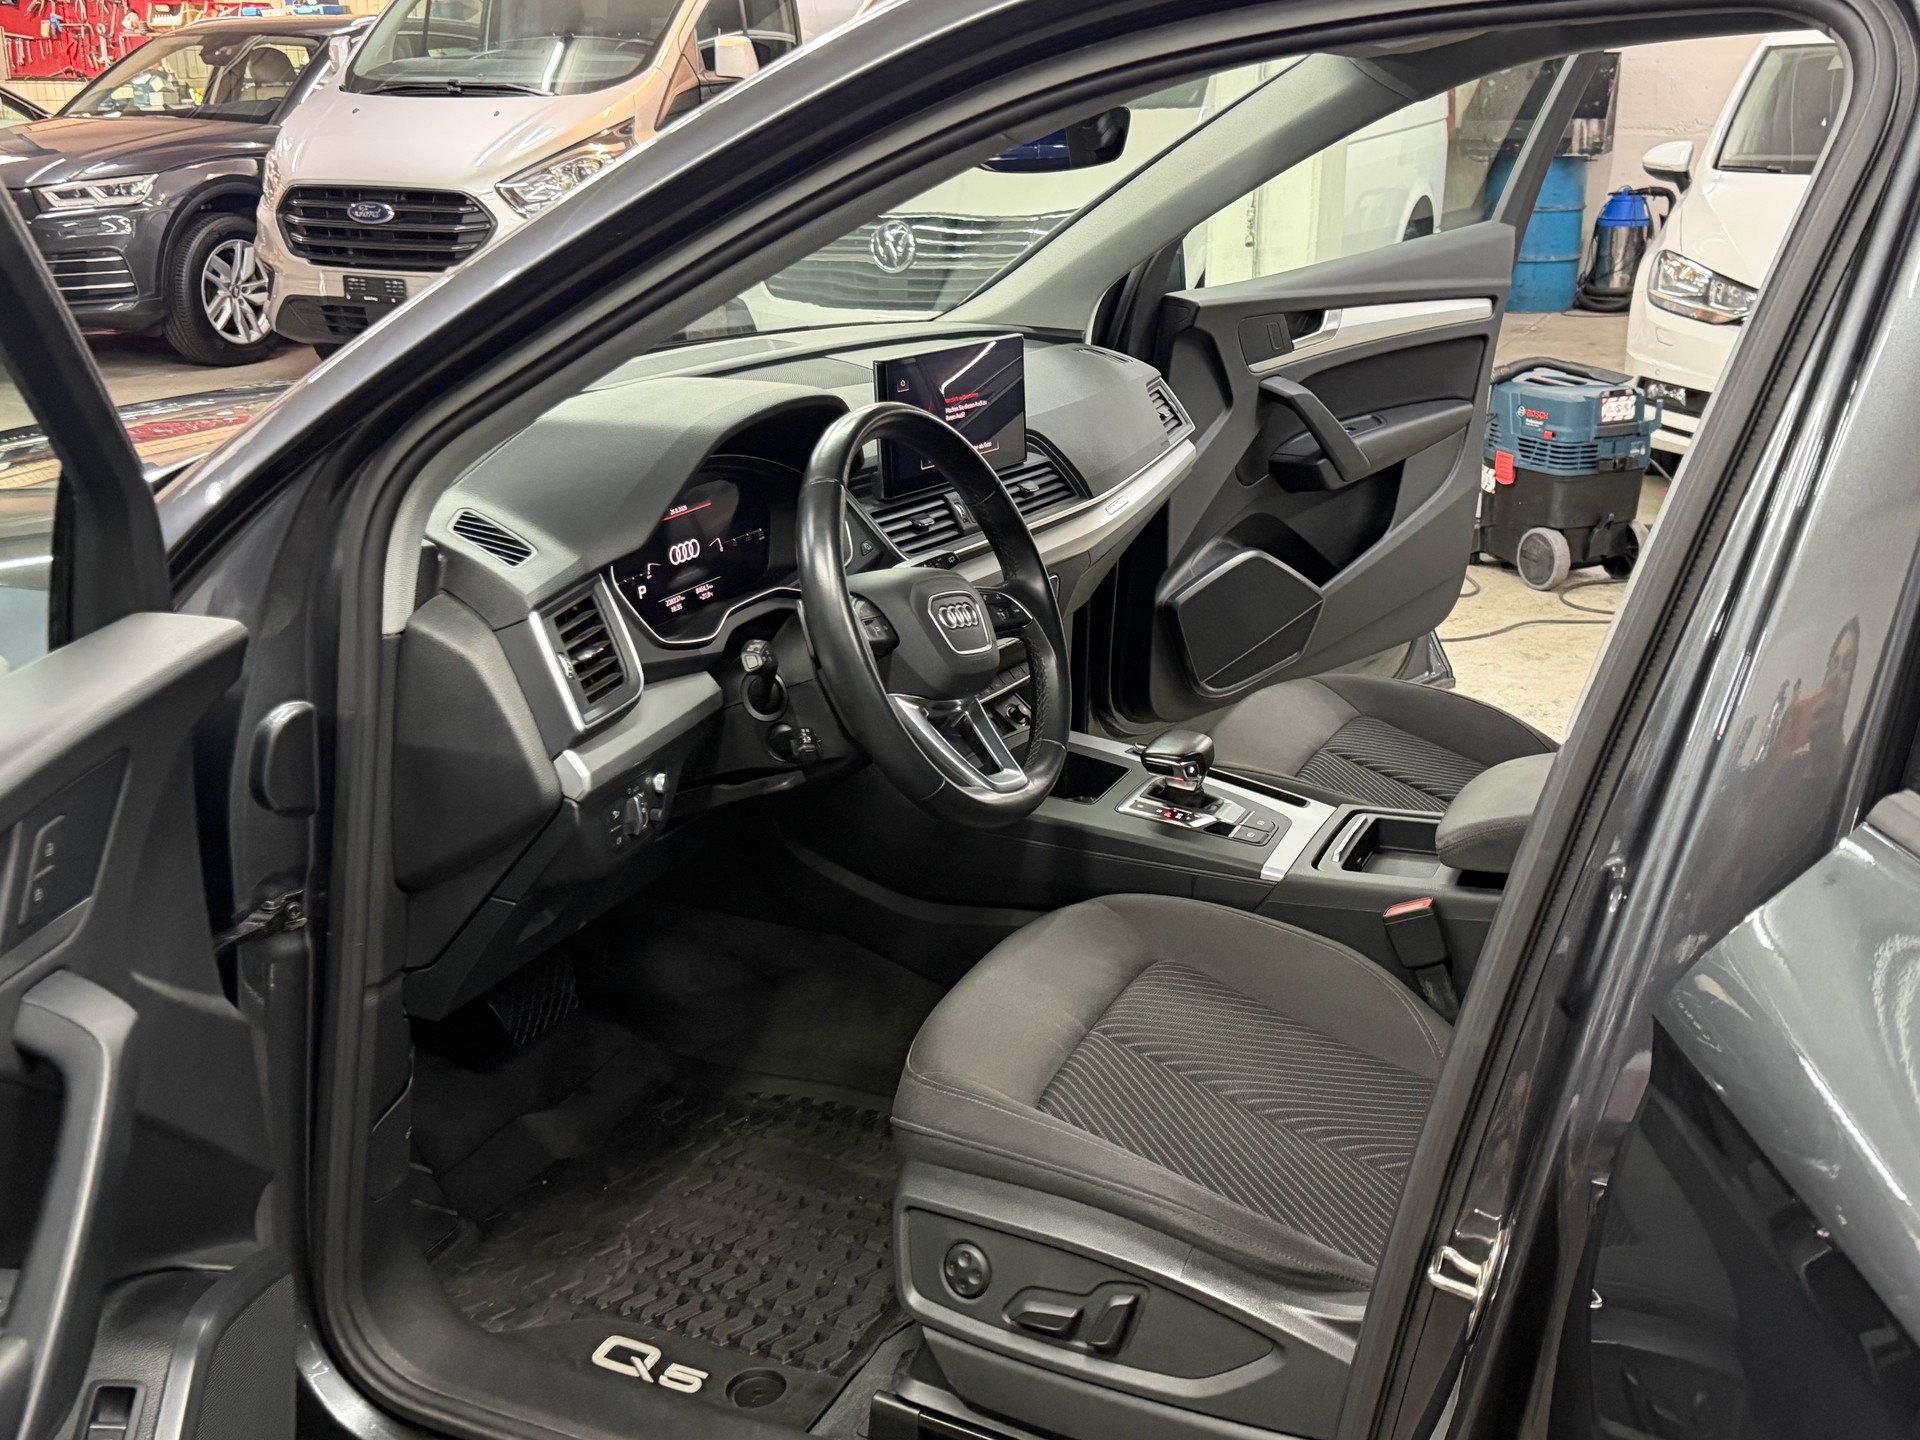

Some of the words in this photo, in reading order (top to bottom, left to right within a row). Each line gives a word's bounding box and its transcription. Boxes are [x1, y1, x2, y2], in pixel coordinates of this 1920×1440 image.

[1526, 409, 1549, 420] BOSCH
[637, 585, 647, 600] P
[591, 1335, 709, 1394] Q5
